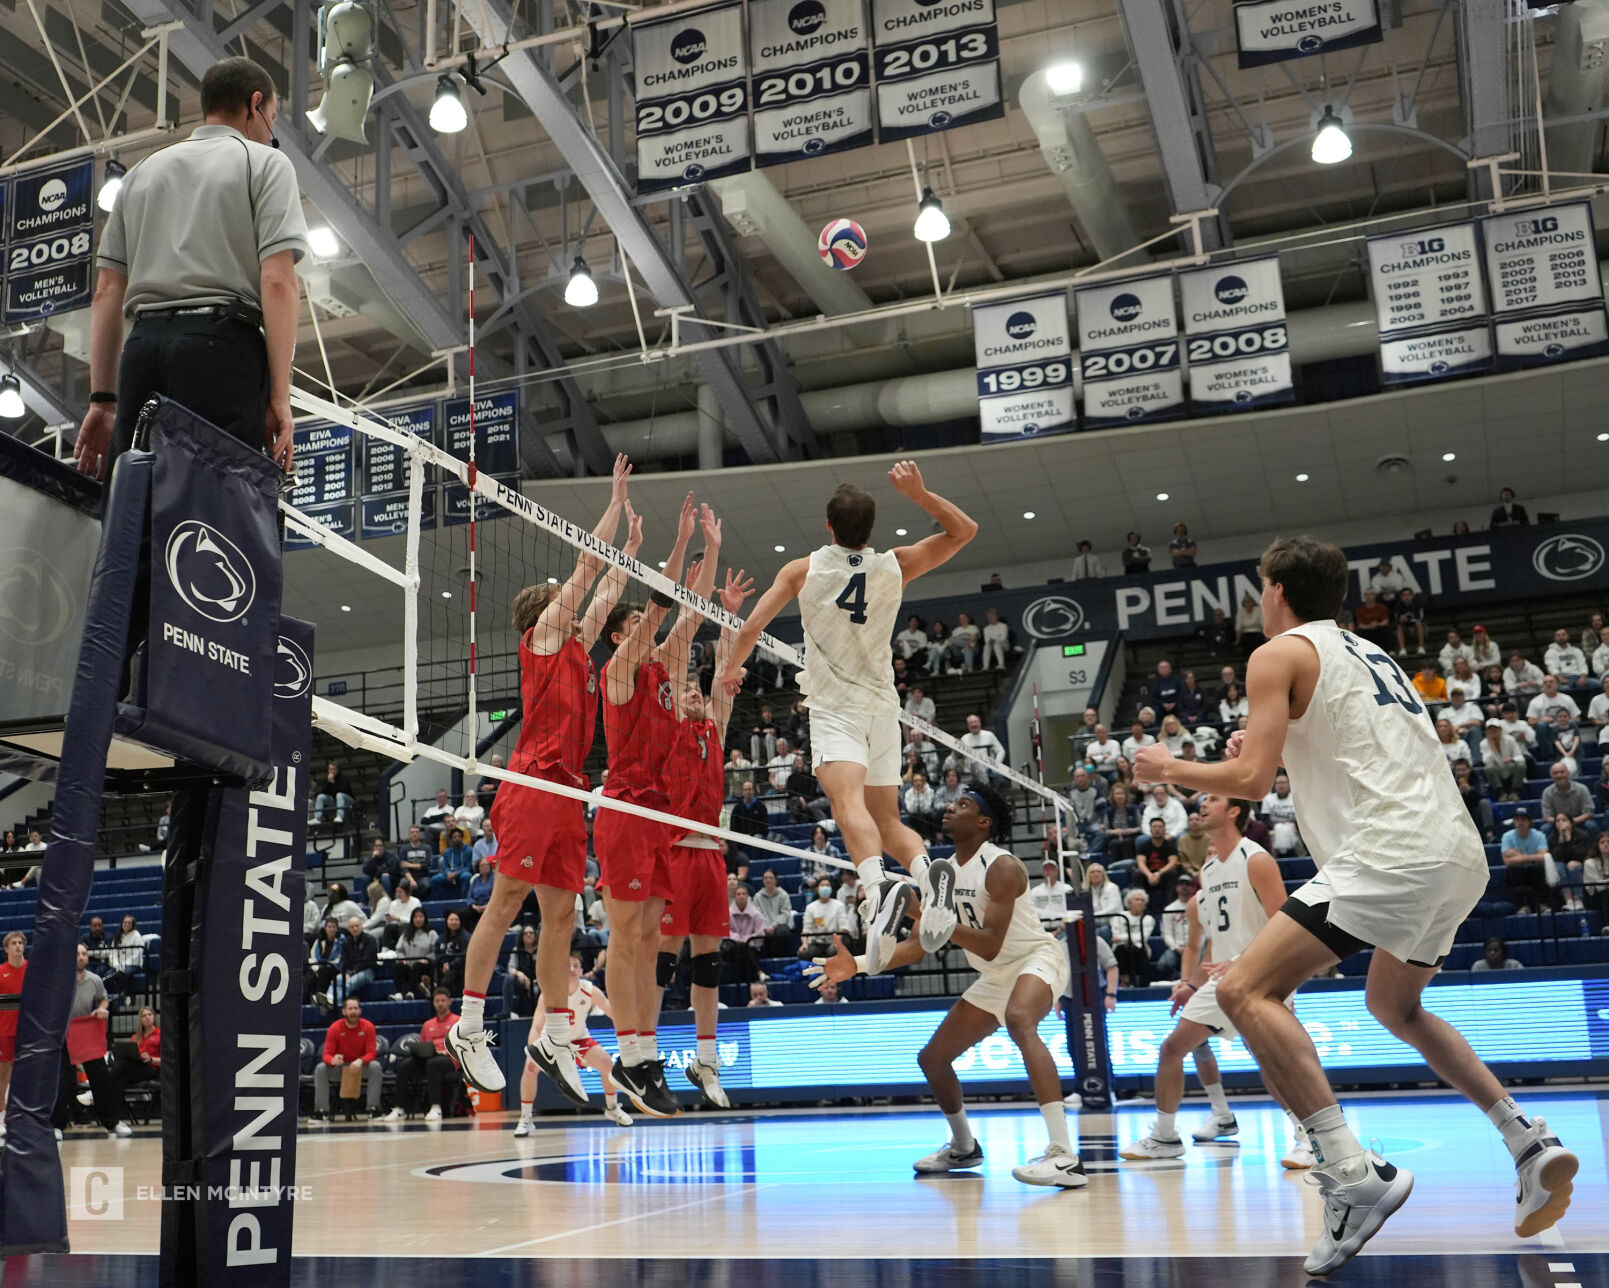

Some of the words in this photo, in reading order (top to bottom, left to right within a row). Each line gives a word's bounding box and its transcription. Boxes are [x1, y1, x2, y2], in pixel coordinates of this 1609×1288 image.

[792, 11, 825, 30] NCAA
[884, 0, 984, 31] CHAMPIONS
[1270, 2, 1342, 24] WOMEN'S
[1261, 13, 1355, 39] VOLLEYBALL
[675, 40, 705, 58] NCAA
[761, 27, 859, 59] CHAMPIONS
[883, 34, 988, 76] 2013
[643, 56, 738, 87] CHAMPIONS
[760, 61, 861, 104] 2010
[907, 80, 970, 101] WOMEN'S
[638, 88, 744, 131] 2009
[898, 90, 981, 116] VOLLEYBALL
[782, 107, 844, 129] WOMEN'S
[772, 118, 854, 141] VOLLEYBALL
[664, 134, 723, 155] WOMEN'S
[654, 145, 733, 168] VOLLEYBALL
[41, 192, 65, 204] NCAA
[17, 204, 86, 230] CHAMPIONS
[10, 232, 90, 270] 2008
[1495, 230, 1584, 253] CHAMPIONS
[1380, 250, 1471, 273] CHAMPIONS
[1500, 258, 1534, 269] 2005
[1549, 250, 1584, 261] 2006
[1501, 267, 1535, 278] 2007
[1550, 259, 1586, 270] 2008
[34, 275, 64, 289] MEN'S
[1387, 279, 1419, 291] 1992
[1437, 271, 1469, 282] 1993
[1502, 277, 1537, 288] 2009
[1553, 269, 1586, 280] 2010
[1504, 286, 1536, 297] 2012
[1554, 279, 1587, 289] 2013
[20, 283, 77, 302] VOLLEYBALL
[1218, 286, 1249, 300] NCAA
[1388, 291, 1420, 302] 1996
[1439, 282, 1470, 293] 1997
[1440, 294, 1471, 305] 1999
[1506, 295, 1538, 306] 2017
[1114, 305, 1143, 317] NCAA
[1193, 301, 1278, 322] CHAMPIONS
[1390, 313, 1425, 325] 2003
[1440, 305, 1474, 316] 2004
[1008, 322, 1037, 335] NCAA
[1088, 319, 1170, 340] CHAMPIONS
[1522, 318, 1580, 333] WOMEN'S
[984, 336, 1063, 356] CHAMPIONS
[1190, 328, 1287, 360] 2008
[1407, 336, 1465, 351] WOMEN'S
[1514, 328, 1590, 345] VOLLEYBALL
[1085, 345, 1177, 377] 2007
[1400, 344, 1474, 362] VOLLEYBALL
[983, 364, 1066, 393] 1999
[1207, 376, 1277, 391] VOLLEYBALL
[1214, 367, 1268, 381] WOMEN'S
[1101, 392, 1168, 408] VOLLEYBALL
[1108, 383, 1160, 398] WOMEN'S
[450, 406, 512, 425] CHAMPIONS
[997, 408, 1062, 424] VOLLEYBALL
[1004, 400, 1054, 413] WOMEN'S
[293, 436, 350, 453] CHAMPIONS
[310, 430, 331, 441] EIVA
[293, 486, 315, 496] 2000
[324, 481, 344, 490] 2001
[386, 502, 409, 512] MEN'
[497, 483, 533, 515] PENN
[536, 506, 572, 537] STATE
[577, 529, 644, 577] VOLLEYBALL
[674, 584, 698, 606] PENN
[701, 600, 725, 622] STATE
[835, 573, 868, 624] 4
[164, 622, 205, 656] PENN
[208, 641, 250, 675] STATE
[1069, 670, 1086, 684] S3
[1345, 645, 1422, 714] 13
[239, 765, 297, 1006] STATE
[1083, 1013, 1094, 1039] PENN
[1085, 1041, 1097, 1070] STATE
[226, 1033, 287, 1267] PENN
